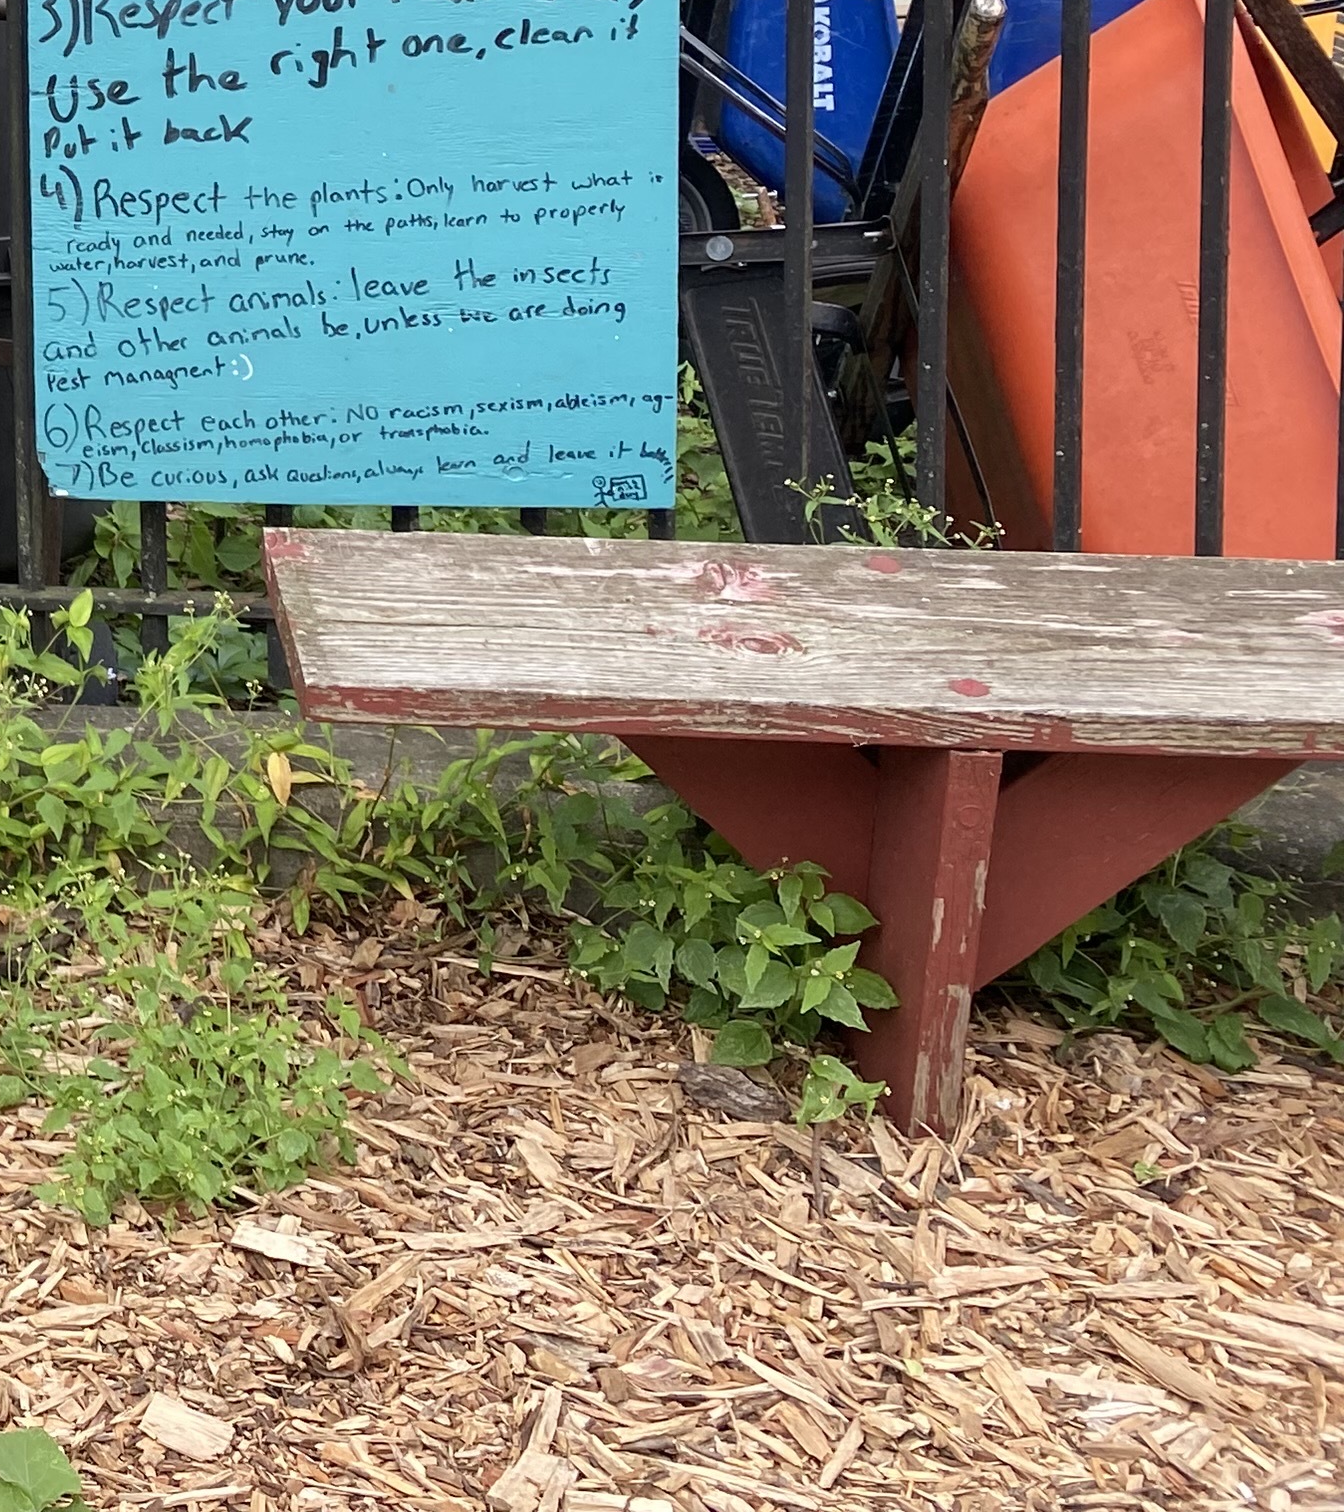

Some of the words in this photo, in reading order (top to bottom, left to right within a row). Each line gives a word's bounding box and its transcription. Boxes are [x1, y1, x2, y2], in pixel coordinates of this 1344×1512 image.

[46, 74, 141, 123] Use
[162, 47, 248, 98] the
[270, 26, 386, 88] right
[402, 34, 486, 60] one,
[495, 19, 593, 49] clean
[610, 13, 639, 40] it
[813, 6, 835, 111] KOBALT
[111, 117, 143, 152] it
[93, 178, 227, 225] Respect
[244, 185, 298, 209] the
[407, 176, 454, 207] Only
[472, 171, 557, 192] harvest
[571, 170, 634, 190] what
[649, 171, 665, 183] is
[67, 231, 122, 258] ready
[133, 226, 173, 247] and
[186, 221, 254, 244] needed,
[261, 224, 295, 246] stay
[308, 225, 330, 236] on
[344, 219, 375, 232] the
[444, 213, 488, 227] learn
[500, 208, 520, 223] to
[534, 199, 626, 226] properly
[200, 248, 242, 267] and
[255, 253, 315, 272] prune.
[351, 266, 430, 301] leave
[453, 258, 497, 290] the
[43, 331, 98, 362] and
[117, 326, 189, 357] other
[207, 315, 302, 347] animals
[364, 306, 442, 334] unless
[509, 303, 546, 323] are
[562, 296, 626, 323] doing
[201, 409, 256, 431] each
[265, 409, 338, 429] other:
[339, 432, 362, 443] or
[244, 465, 279, 482] ask
[437, 456, 476, 474] learn
[493, 441, 531, 465] and
[550, 444, 597, 463] leave
[610, 441, 632, 459] it
